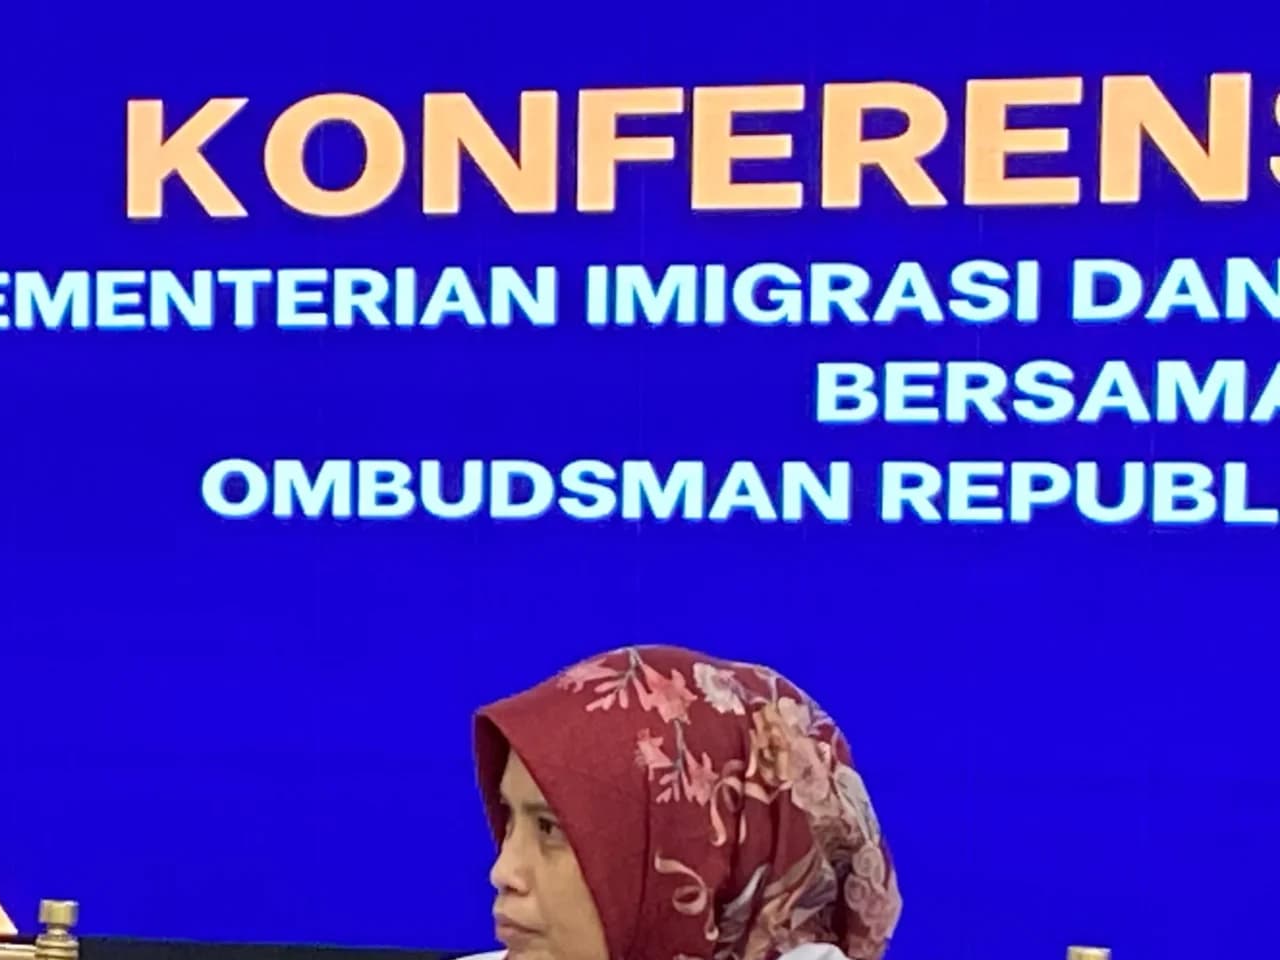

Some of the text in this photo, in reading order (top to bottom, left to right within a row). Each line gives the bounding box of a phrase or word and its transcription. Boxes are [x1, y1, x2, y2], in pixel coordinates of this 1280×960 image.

[126, 72, 1280, 219] KONFEREN
[587, 260, 1040, 326] IMIGRASI
[1071, 257, 1280, 322] DAN
[201, 458, 1280, 524] OMBUDSMAN REPUBL
